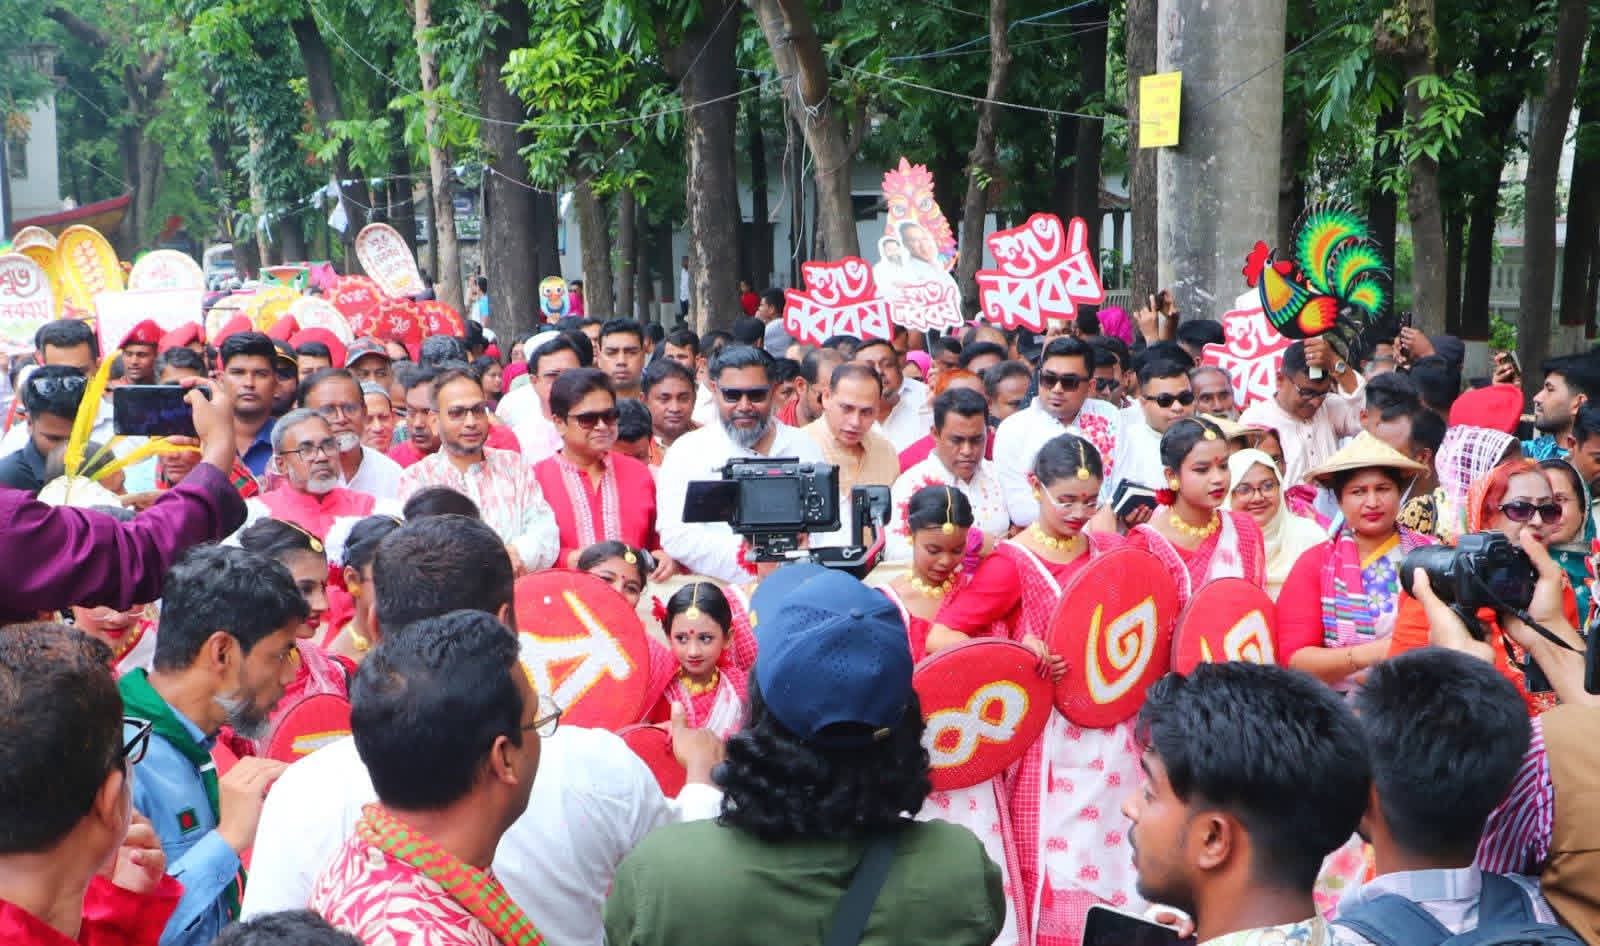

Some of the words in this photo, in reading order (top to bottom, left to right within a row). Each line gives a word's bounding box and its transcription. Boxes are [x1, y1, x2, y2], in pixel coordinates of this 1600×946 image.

[977, 221, 1102, 328] নববর্ষ
[990, 218, 1061, 277] শুভ
[805, 260, 868, 306] শুভ
